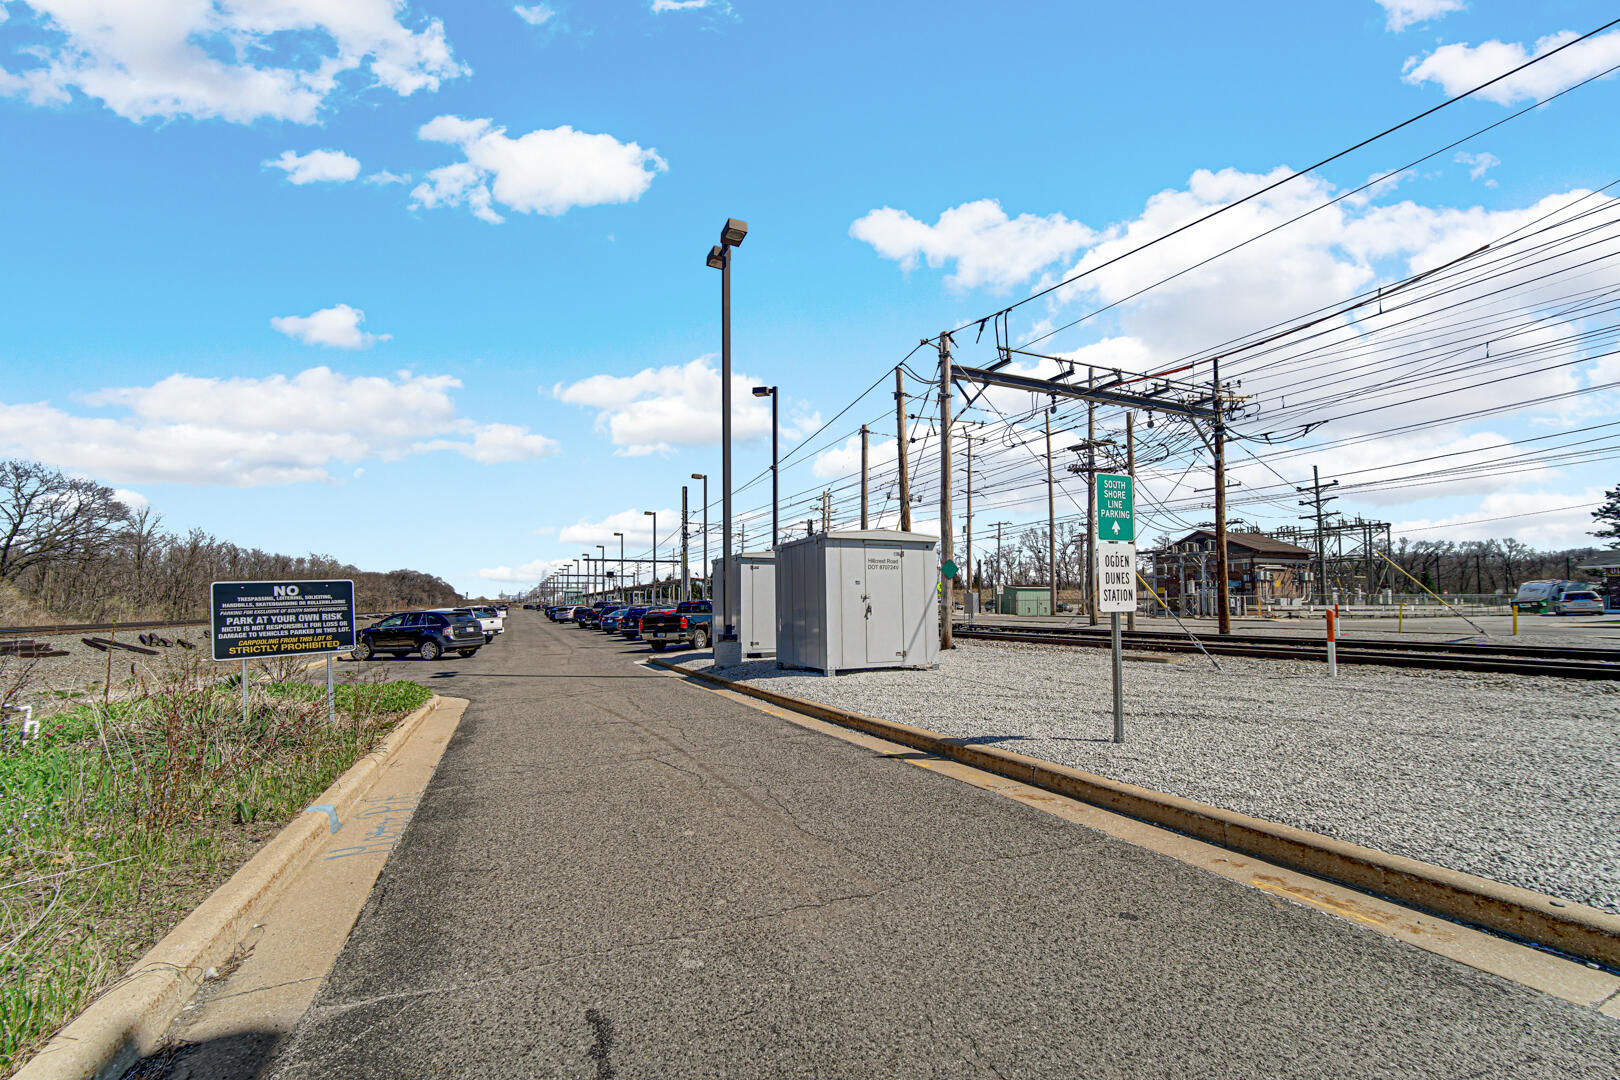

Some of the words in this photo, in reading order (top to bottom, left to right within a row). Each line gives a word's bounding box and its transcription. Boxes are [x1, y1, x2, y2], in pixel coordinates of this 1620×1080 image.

[1104, 480, 1126, 489] SOUTH
[1104, 490, 1126, 499] SHORE
[1107, 500, 1123, 509] LINE
[1100, 509, 1130, 519] PARKING
[1105, 555, 1129, 567] OGDEN
[1105, 572, 1130, 584] DUNES
[273, 585, 300, 596] NO
[1103, 589, 1133, 601] STATION
[226, 616, 254, 625] PARK
[256, 616, 269, 624] AT
[270, 614, 296, 623] YOUR
[298, 614, 320, 622] OWN
[322, 612, 343, 620] RISK
[229, 645, 278, 654] STRICTLY
[281, 640, 340, 650] PROHIBITED
